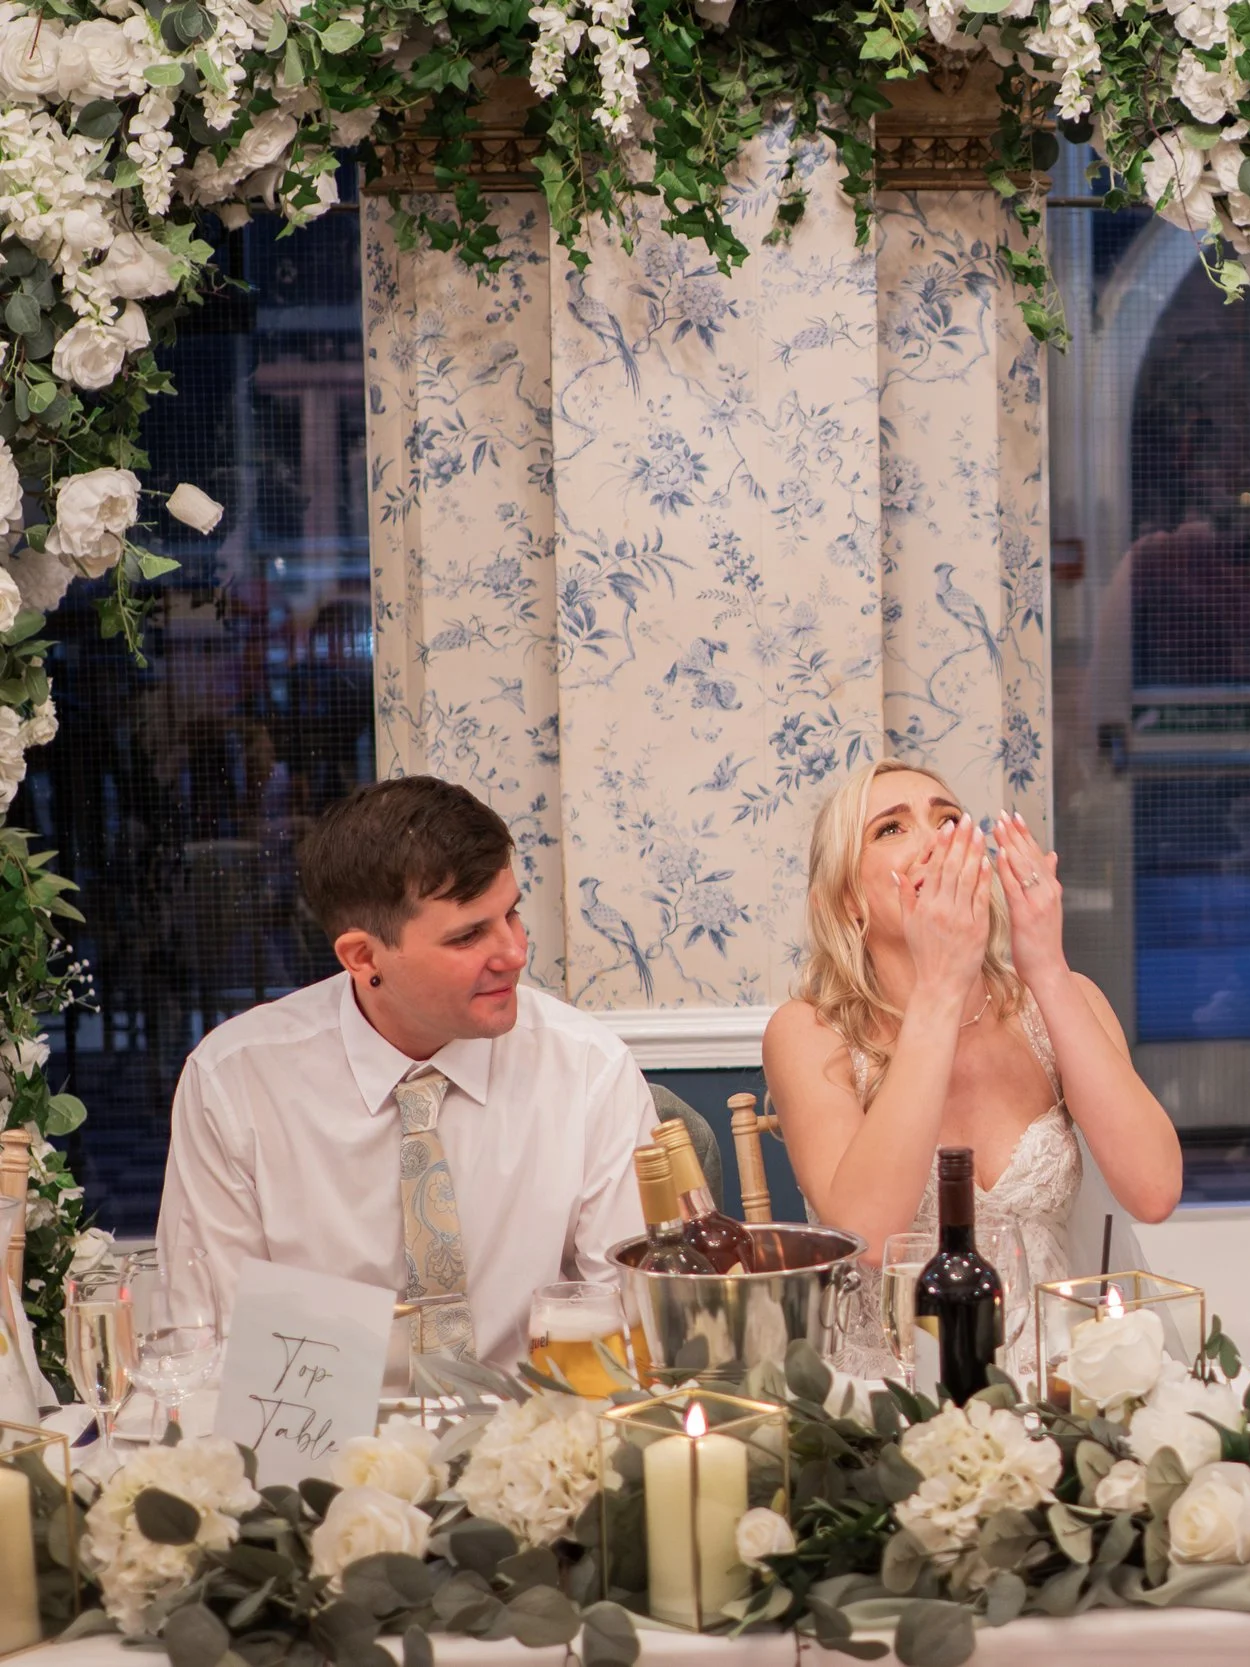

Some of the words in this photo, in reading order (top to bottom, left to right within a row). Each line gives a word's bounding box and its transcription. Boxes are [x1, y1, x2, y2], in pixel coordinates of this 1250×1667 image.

[272, 1332, 340, 1398] Top
[528, 1329, 549, 1354] guel
[249, 1394, 339, 1460] Table
